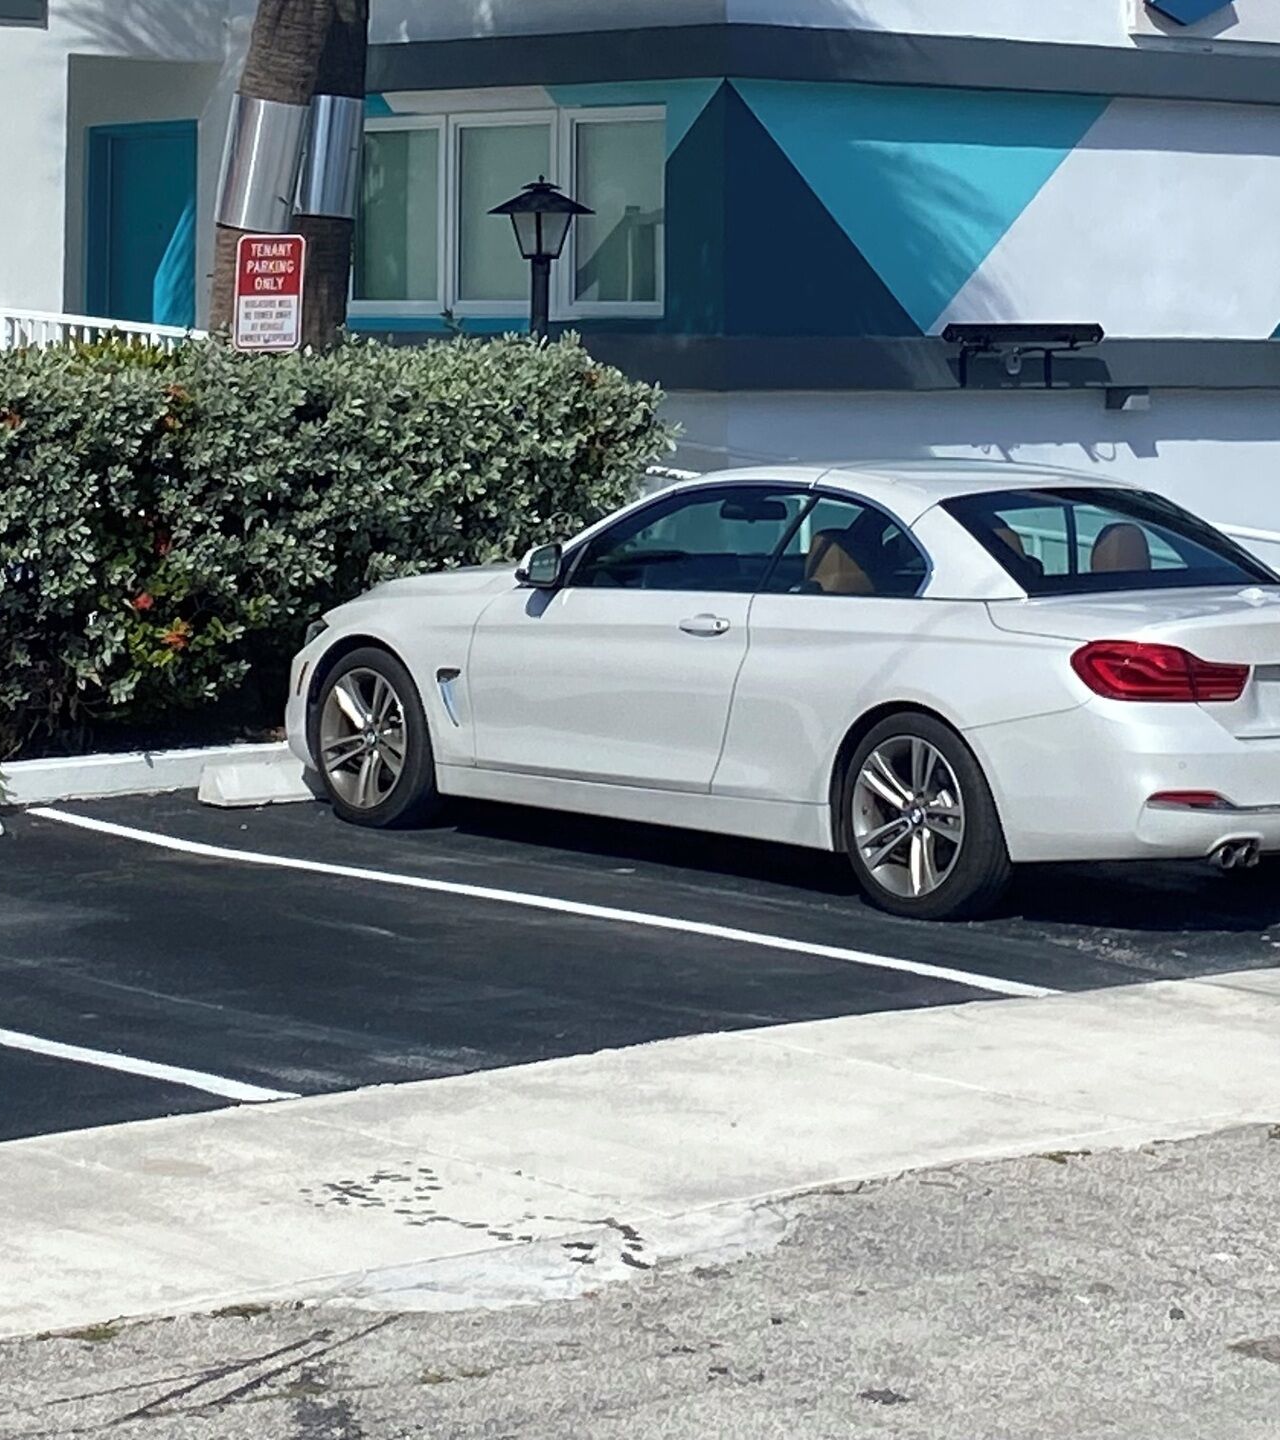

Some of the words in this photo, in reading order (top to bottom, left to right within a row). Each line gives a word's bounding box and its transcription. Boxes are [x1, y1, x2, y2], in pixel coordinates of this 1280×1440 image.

[251, 243, 293, 257] TENANT
[246, 260, 294, 274] PARKING
[254, 277, 284, 290] ONLY
